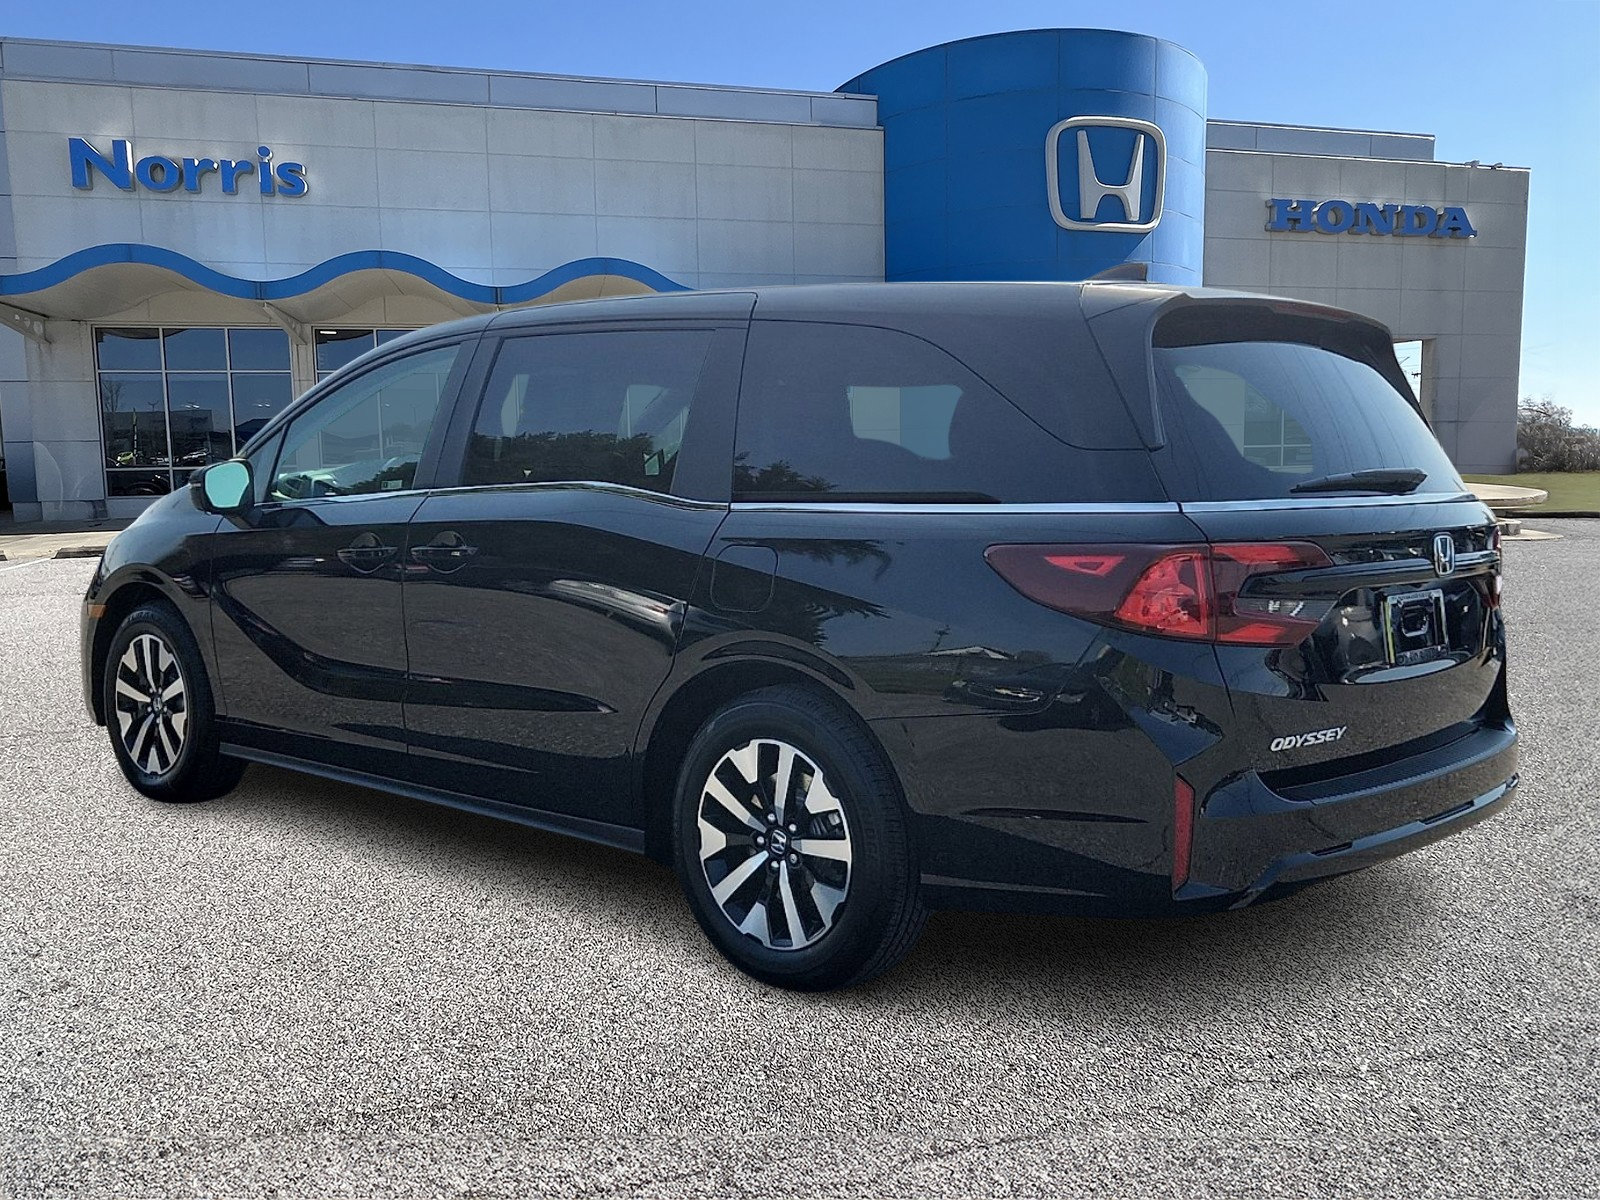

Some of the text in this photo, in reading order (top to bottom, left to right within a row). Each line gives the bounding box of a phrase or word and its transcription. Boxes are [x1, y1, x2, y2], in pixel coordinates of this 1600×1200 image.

[69, 137, 309, 197] Norris
[1265, 198, 1478, 239] HONDA
[1270, 726, 1348, 752] ODYSSEY
